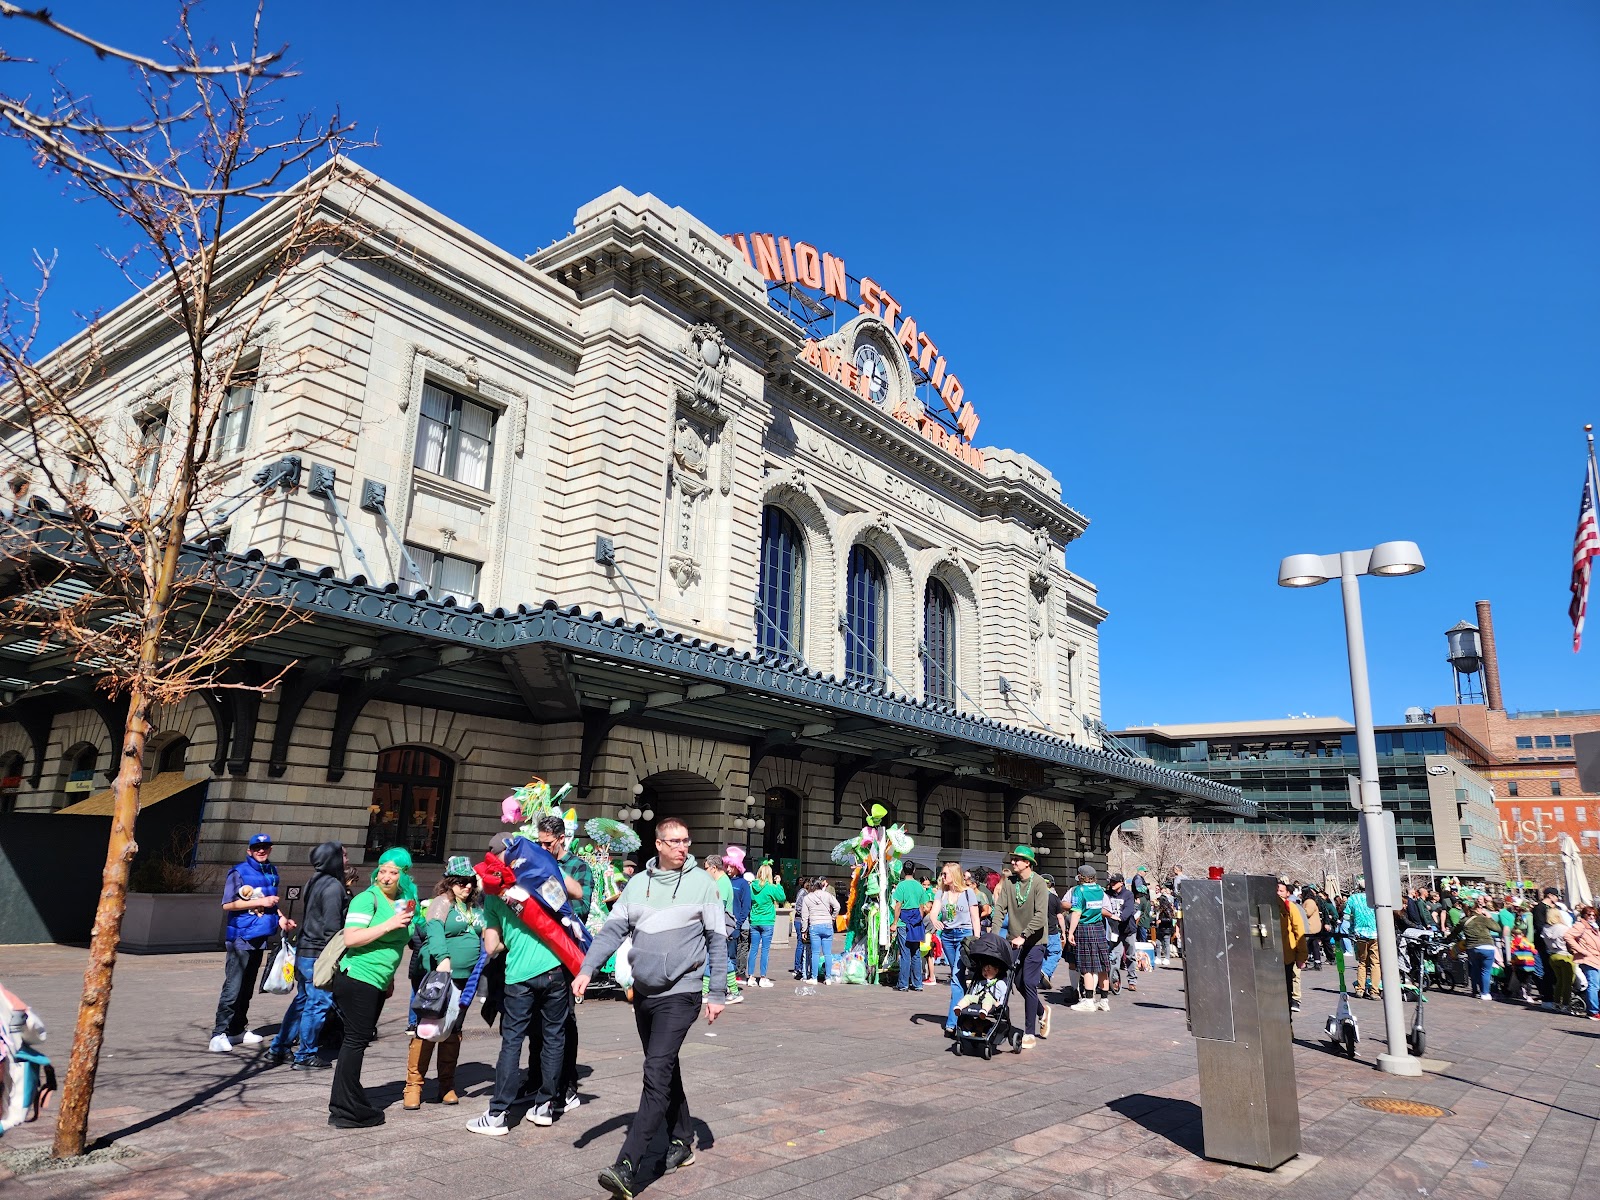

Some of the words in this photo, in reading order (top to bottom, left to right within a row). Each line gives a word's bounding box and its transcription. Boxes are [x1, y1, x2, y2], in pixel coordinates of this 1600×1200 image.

[859, 276, 980, 442] STATION
[917, 413, 984, 476] TRAIN
[884, 474, 948, 522] STATION
[1498, 812, 1558, 843] USE
